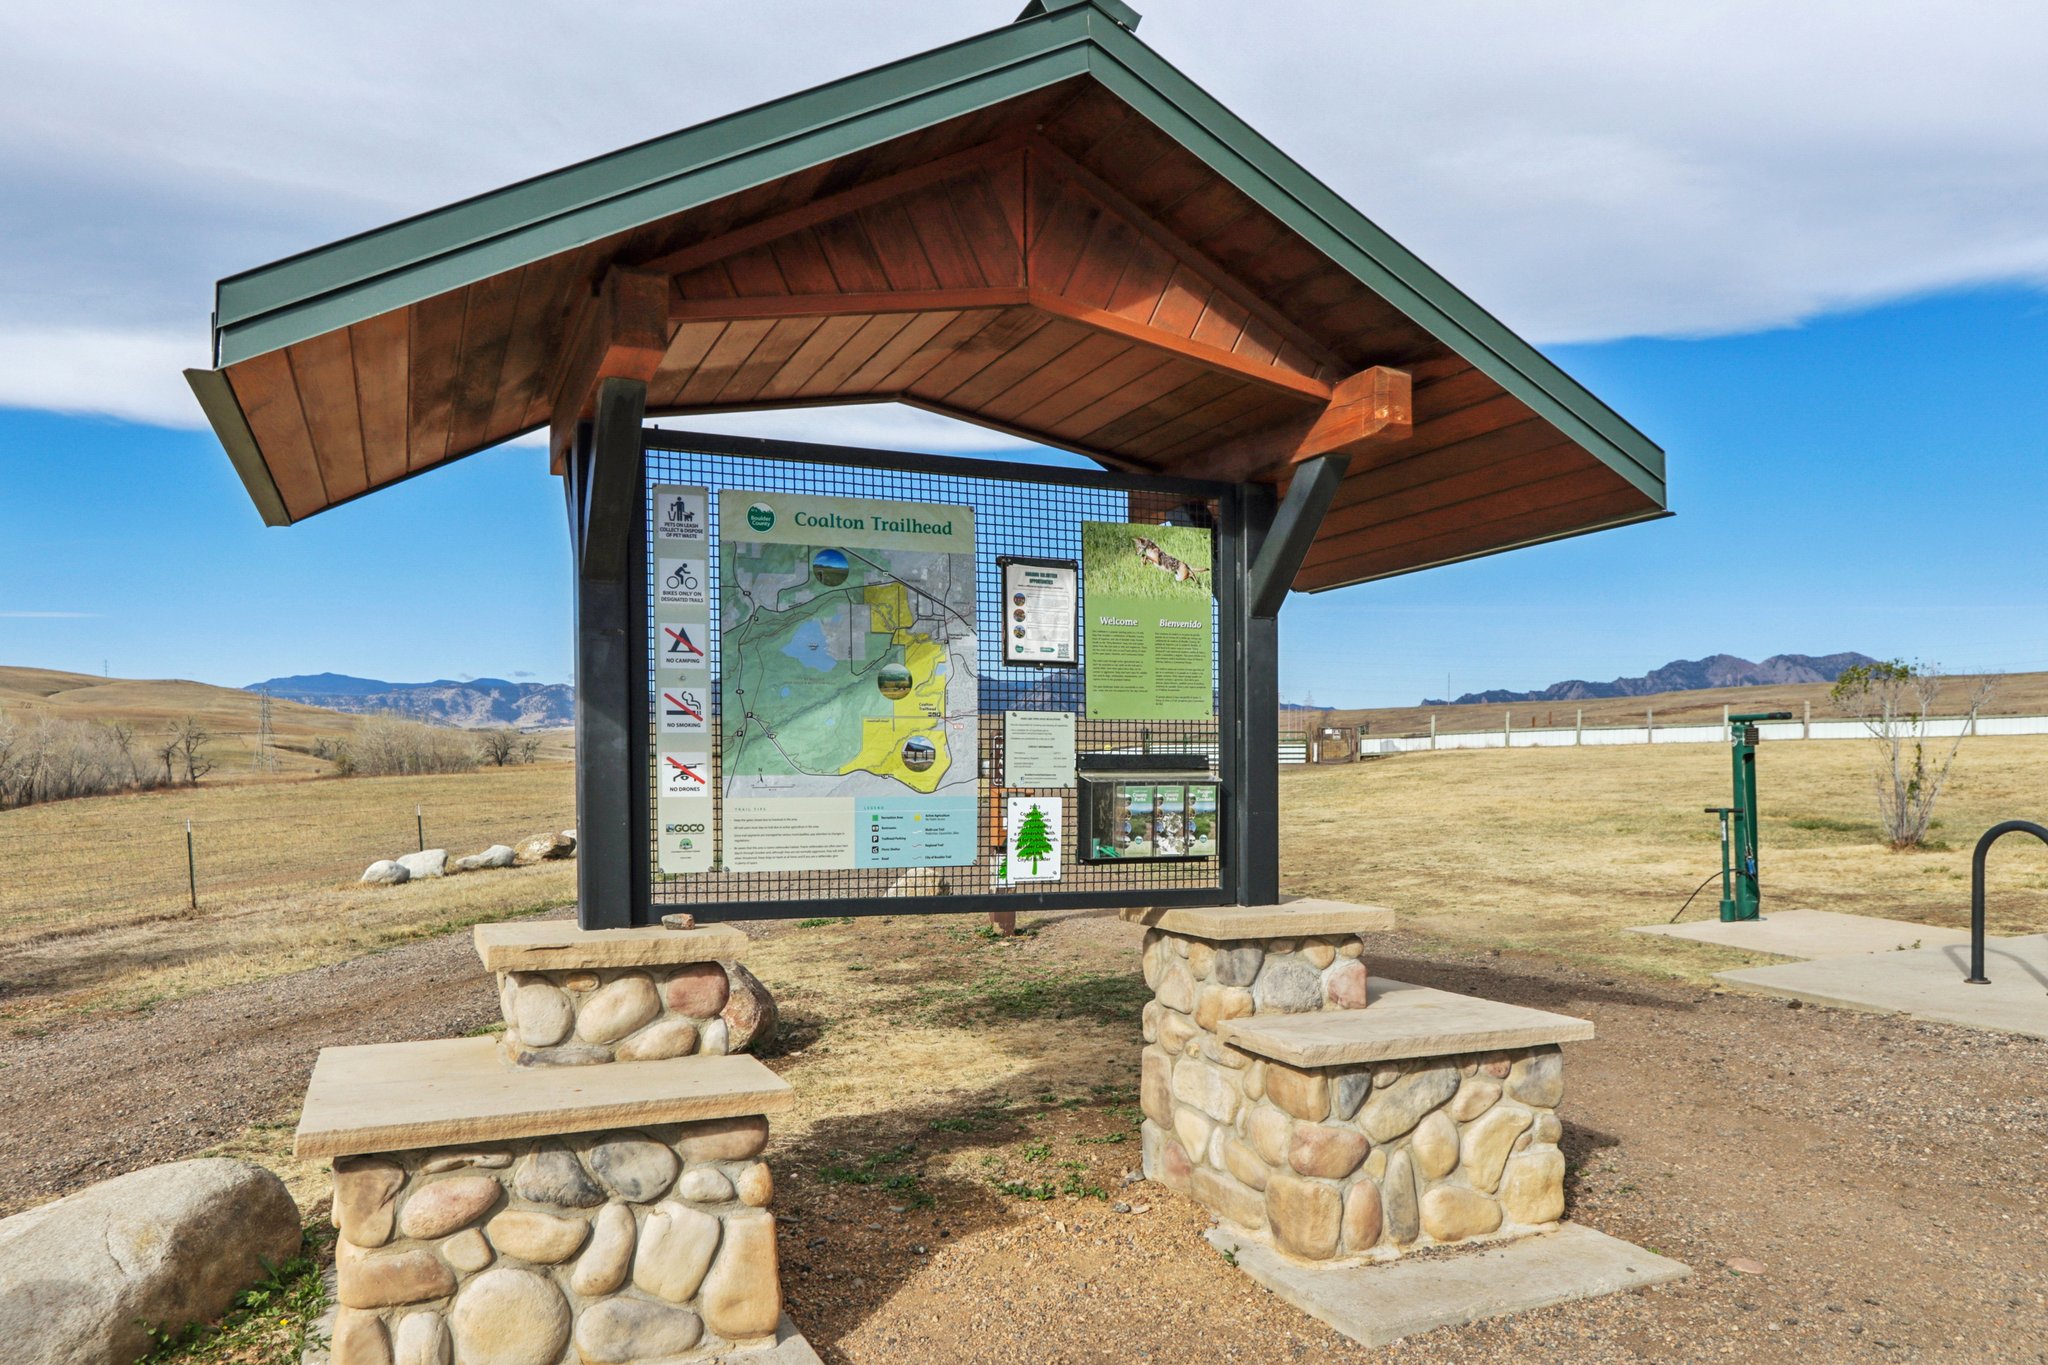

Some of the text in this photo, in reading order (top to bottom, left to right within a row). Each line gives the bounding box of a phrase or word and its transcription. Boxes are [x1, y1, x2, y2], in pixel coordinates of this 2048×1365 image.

[794, 512, 953, 535] Coalton Trailhead
[1100, 616, 1138, 626] Welcome
[1160, 619, 1202, 628] Bienvenido
[674, 824, 704, 832] GOCO
